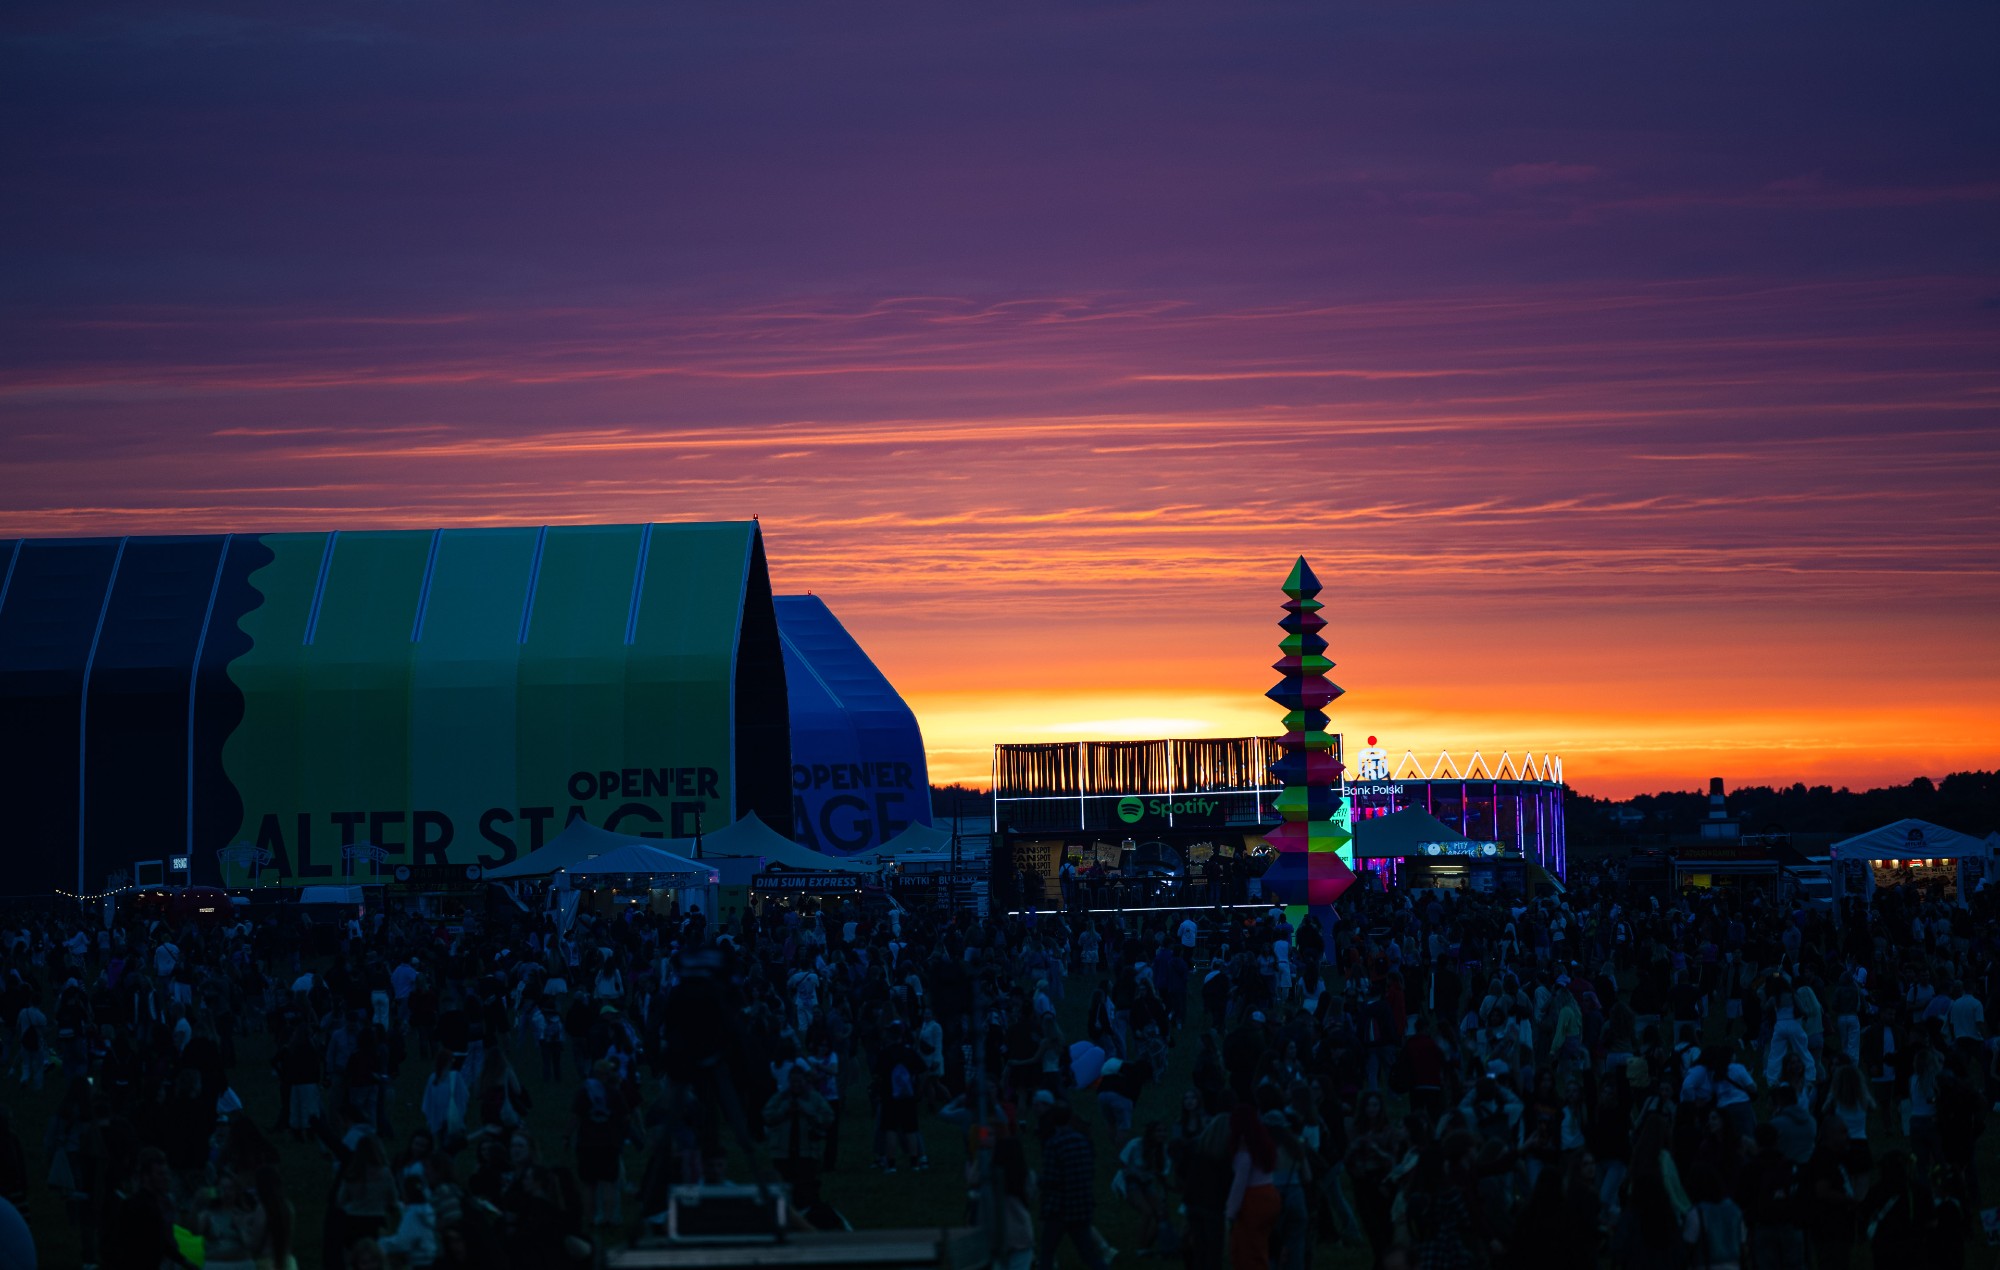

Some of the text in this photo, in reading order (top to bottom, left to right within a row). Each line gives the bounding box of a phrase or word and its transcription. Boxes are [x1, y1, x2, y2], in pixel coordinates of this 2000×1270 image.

[567, 767, 720, 800] OPEN'ER
[792, 761, 914, 790] OPEN'ER
[1344, 785, 1404, 796] Bank Polski
[1149, 797, 1215, 818] Spotify
[247, 801, 707, 879] ALTER STGE
[756, 877, 857, 888] DIM SUM EXPRESS
[899, 876, 930, 886] FRYTKI
